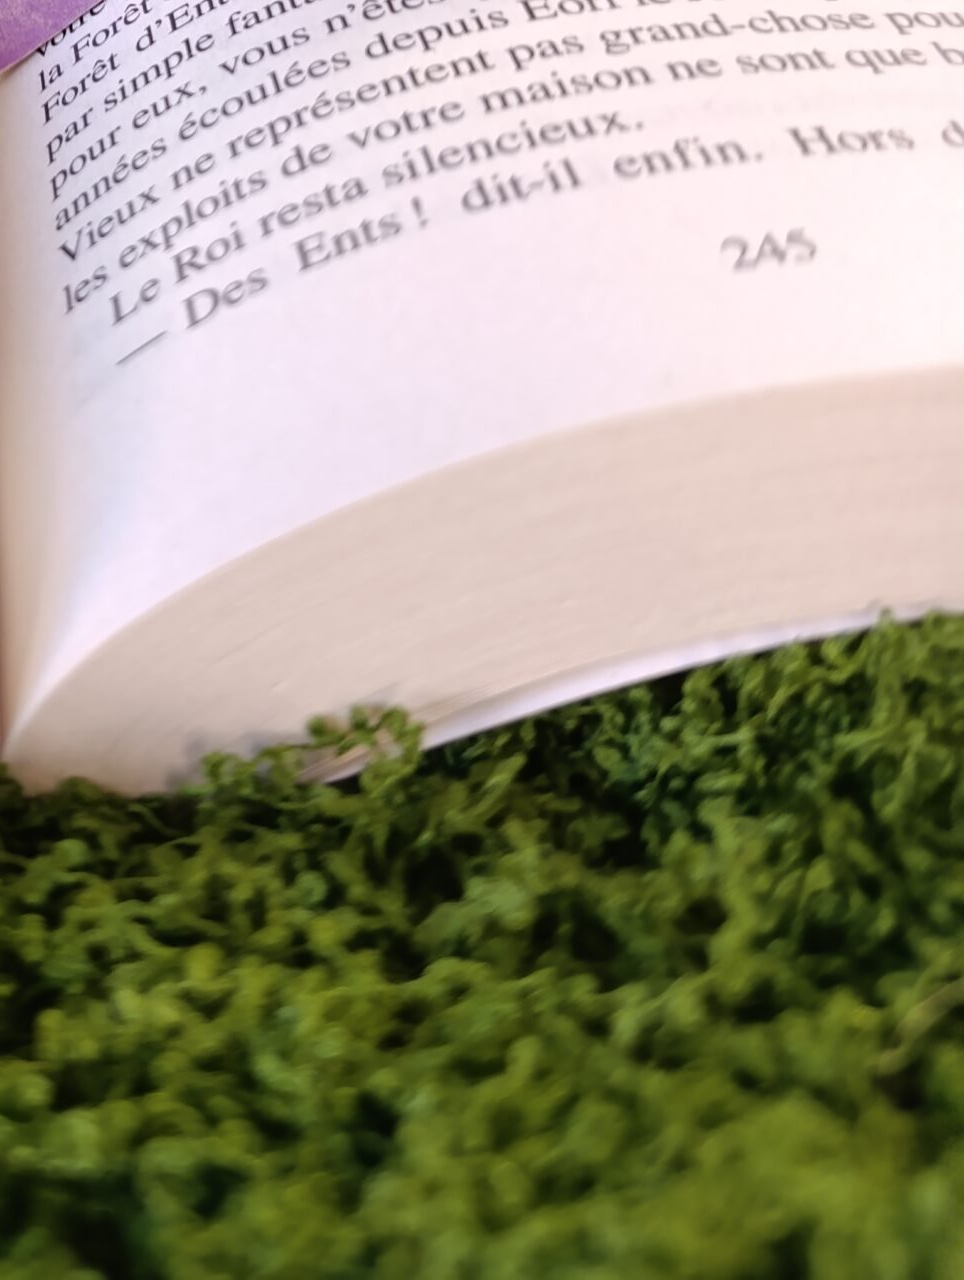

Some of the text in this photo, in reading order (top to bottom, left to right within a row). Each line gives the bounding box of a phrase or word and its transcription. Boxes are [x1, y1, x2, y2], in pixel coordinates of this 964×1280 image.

[38, 61, 64, 94] la
[41, 51, 121, 125] Forêt
[45, 106, 94, 167] par
[103, 30, 216, 113] simple
[49, 124, 122, 203] pour
[132, 79, 209, 130] eux,
[218, 24, 311, 77] vous
[54, 137, 168, 232] années
[178, 49, 352, 143] écoulées
[364, 6, 510, 60] depuis
[57, 9, 876, 263] Vieux ne représentent pas grand-chose
[62, 46, 928, 315] les exploits de votre maison ne sont que
[107, 110, 644, 326] Le Roi resta silencieux.
[180, 122, 916, 331] Des Ents dit-il enfin. Hors
[720, 226, 818, 274] 245
